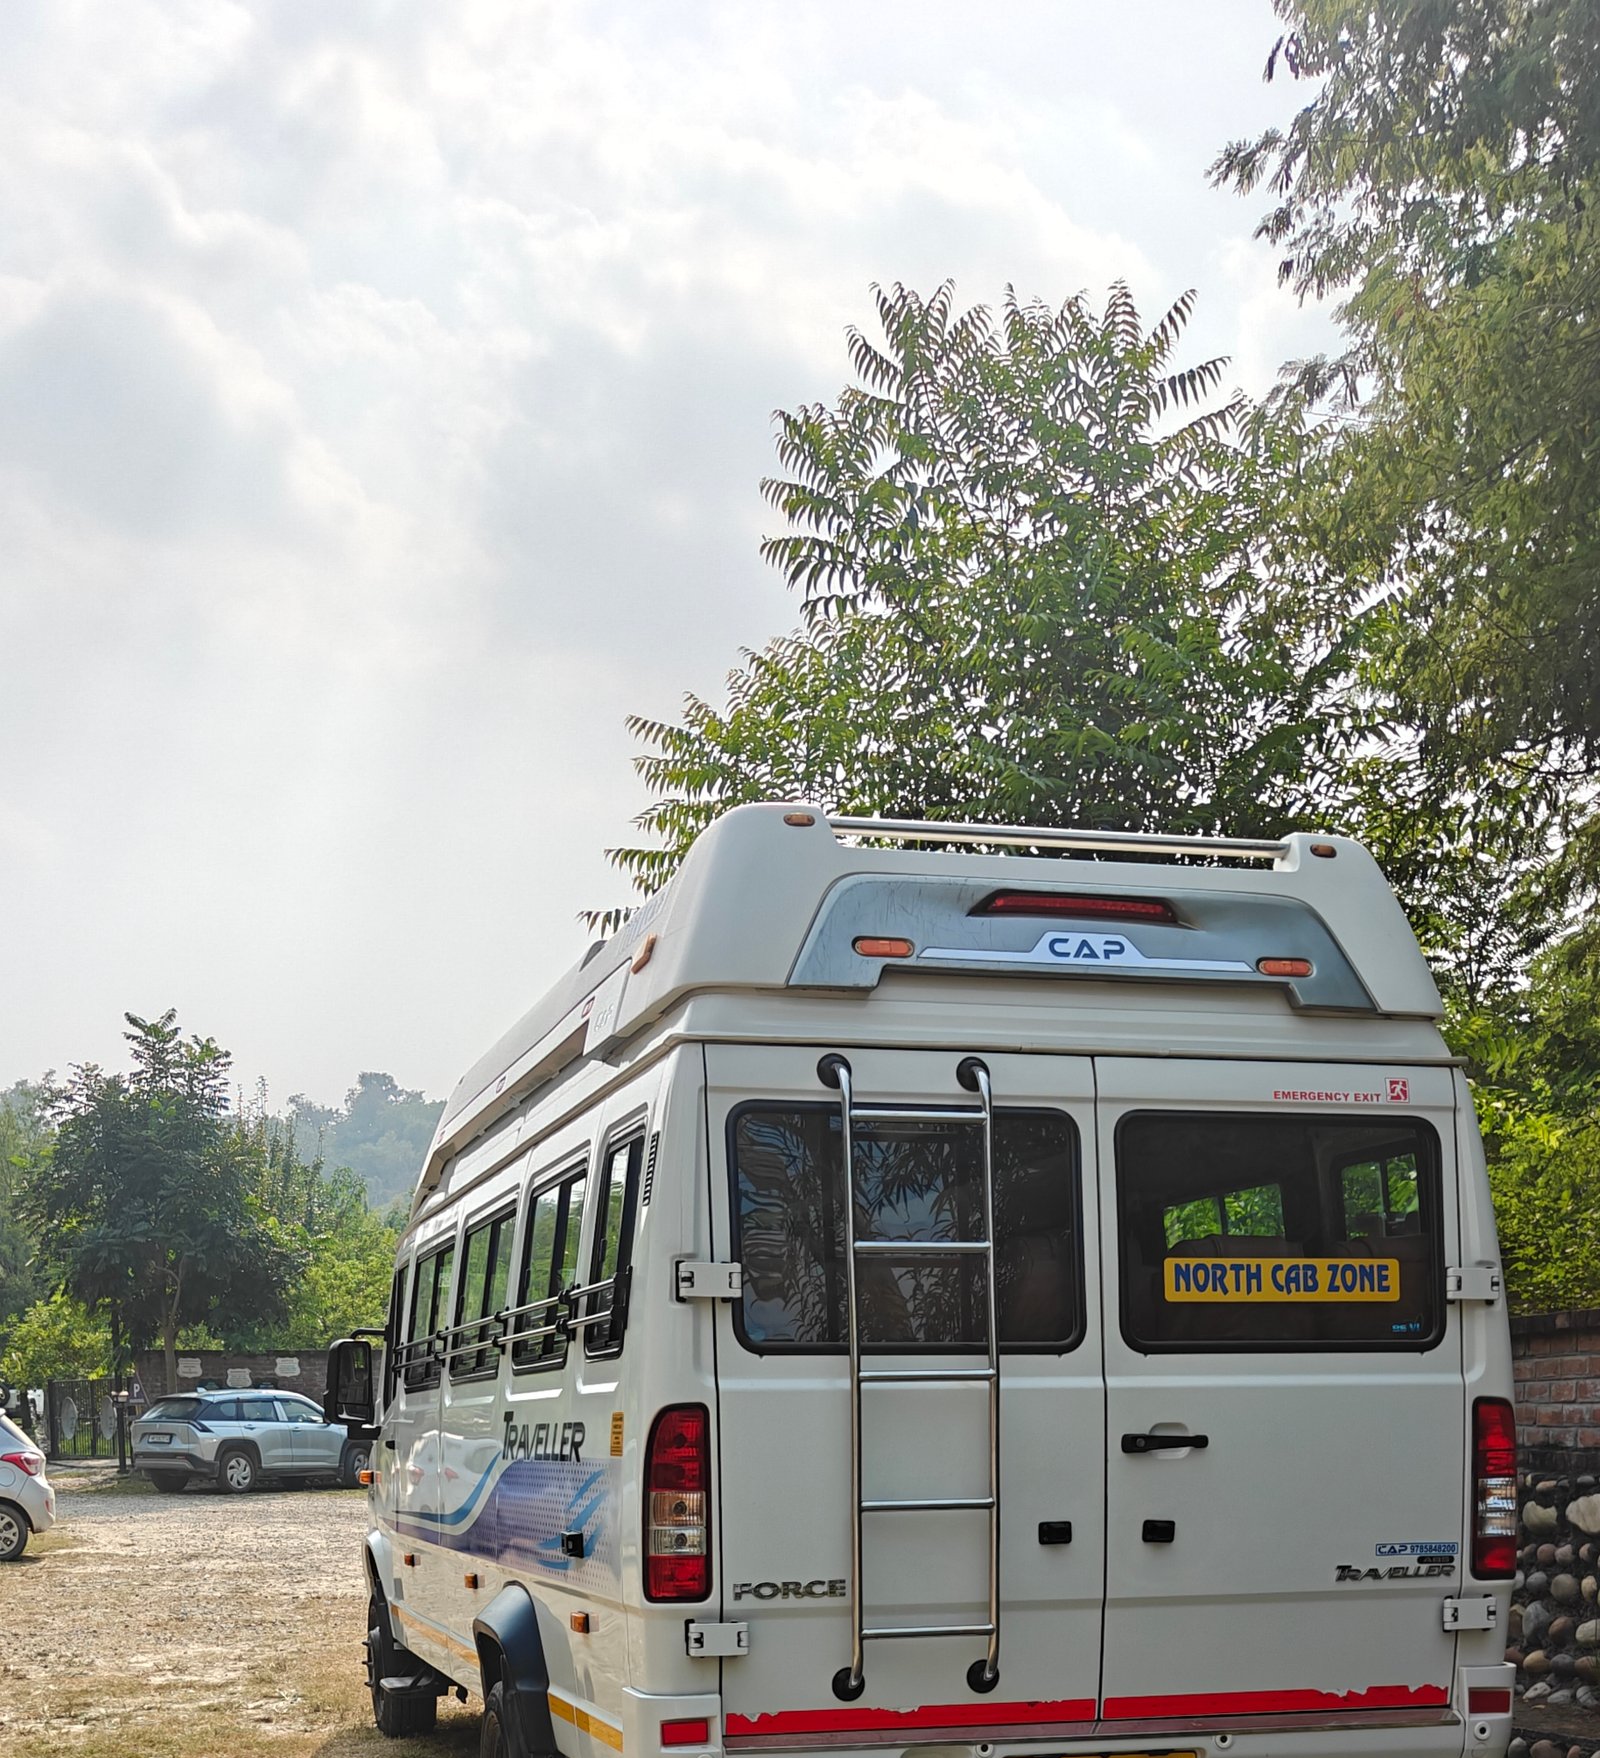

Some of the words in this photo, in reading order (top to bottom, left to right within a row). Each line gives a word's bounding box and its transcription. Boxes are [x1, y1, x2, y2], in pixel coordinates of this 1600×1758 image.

[1048, 937, 1125, 960] CAP
[1273, 1090, 1350, 1102] EMERGENCY
[1353, 1092, 1381, 1103] EXIT
[1174, 1263, 1262, 1296] NORTH
[1271, 1264, 1319, 1296] CAB
[1327, 1264, 1391, 1293] ZONE
[133, 1383, 141, 1398] P
[502, 1411, 586, 1463] TRAVELLER
[1378, 1545, 1408, 1554] CAP
[1410, 1544, 1456, 1553] 9785848200
[1335, 1565, 1455, 1582] TRAVELLER
[733, 1579, 846, 1601] FORCE
